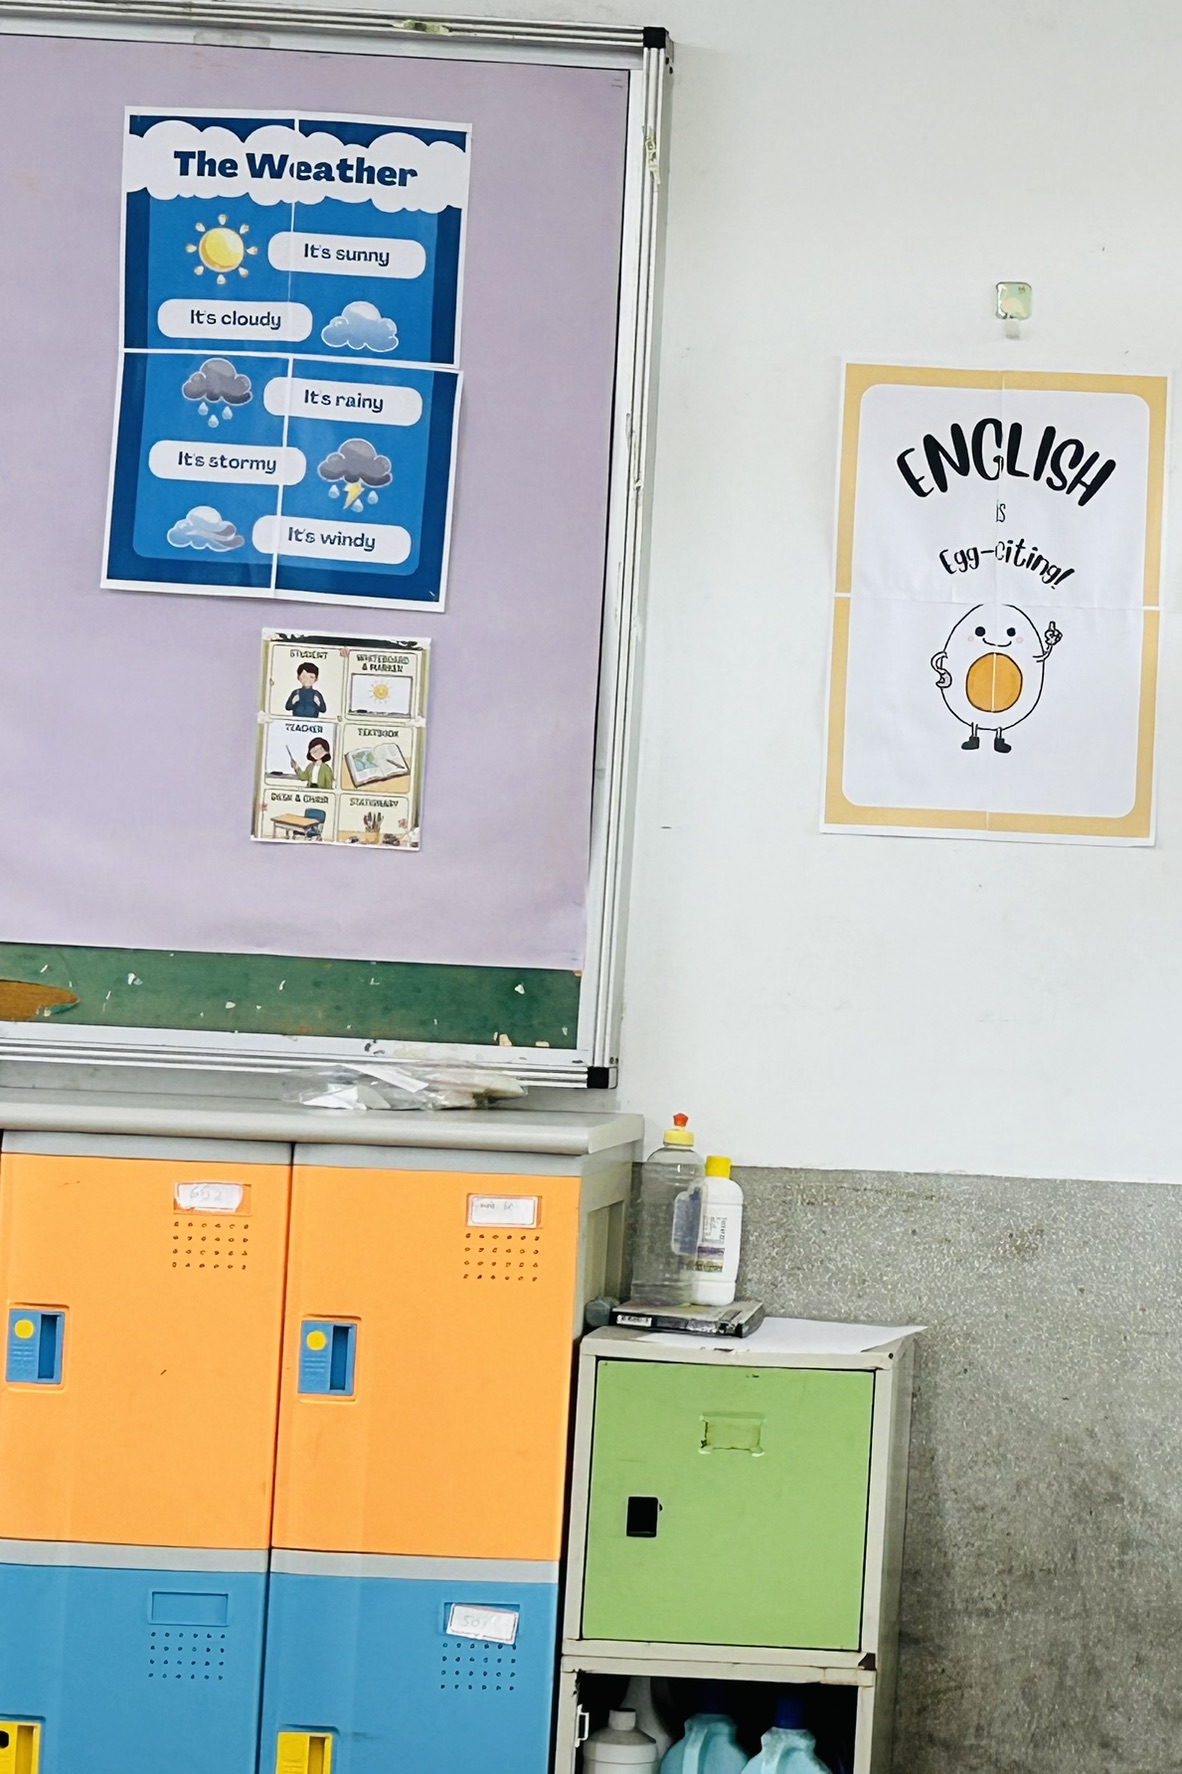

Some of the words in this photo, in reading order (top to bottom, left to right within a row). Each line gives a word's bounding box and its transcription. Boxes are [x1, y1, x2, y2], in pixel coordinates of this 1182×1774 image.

[173, 150, 239, 178] The
[246, 152, 418, 187] Weather
[304, 243, 331, 260] It's
[336, 248, 390, 267] sunny
[190, 309, 217, 326] It's
[221, 310, 281, 330] cloudy
[304, 389, 331, 406] It's
[336, 394, 384, 413] rainy
[178, 451, 205, 468] It's
[209, 453, 277, 474] stormy
[896, 417, 1117, 507] ENGLISH
[287, 526, 315, 543] It's
[320, 531, 376, 552] windy
[938, 538, 1076, 590] Egg-citing!
